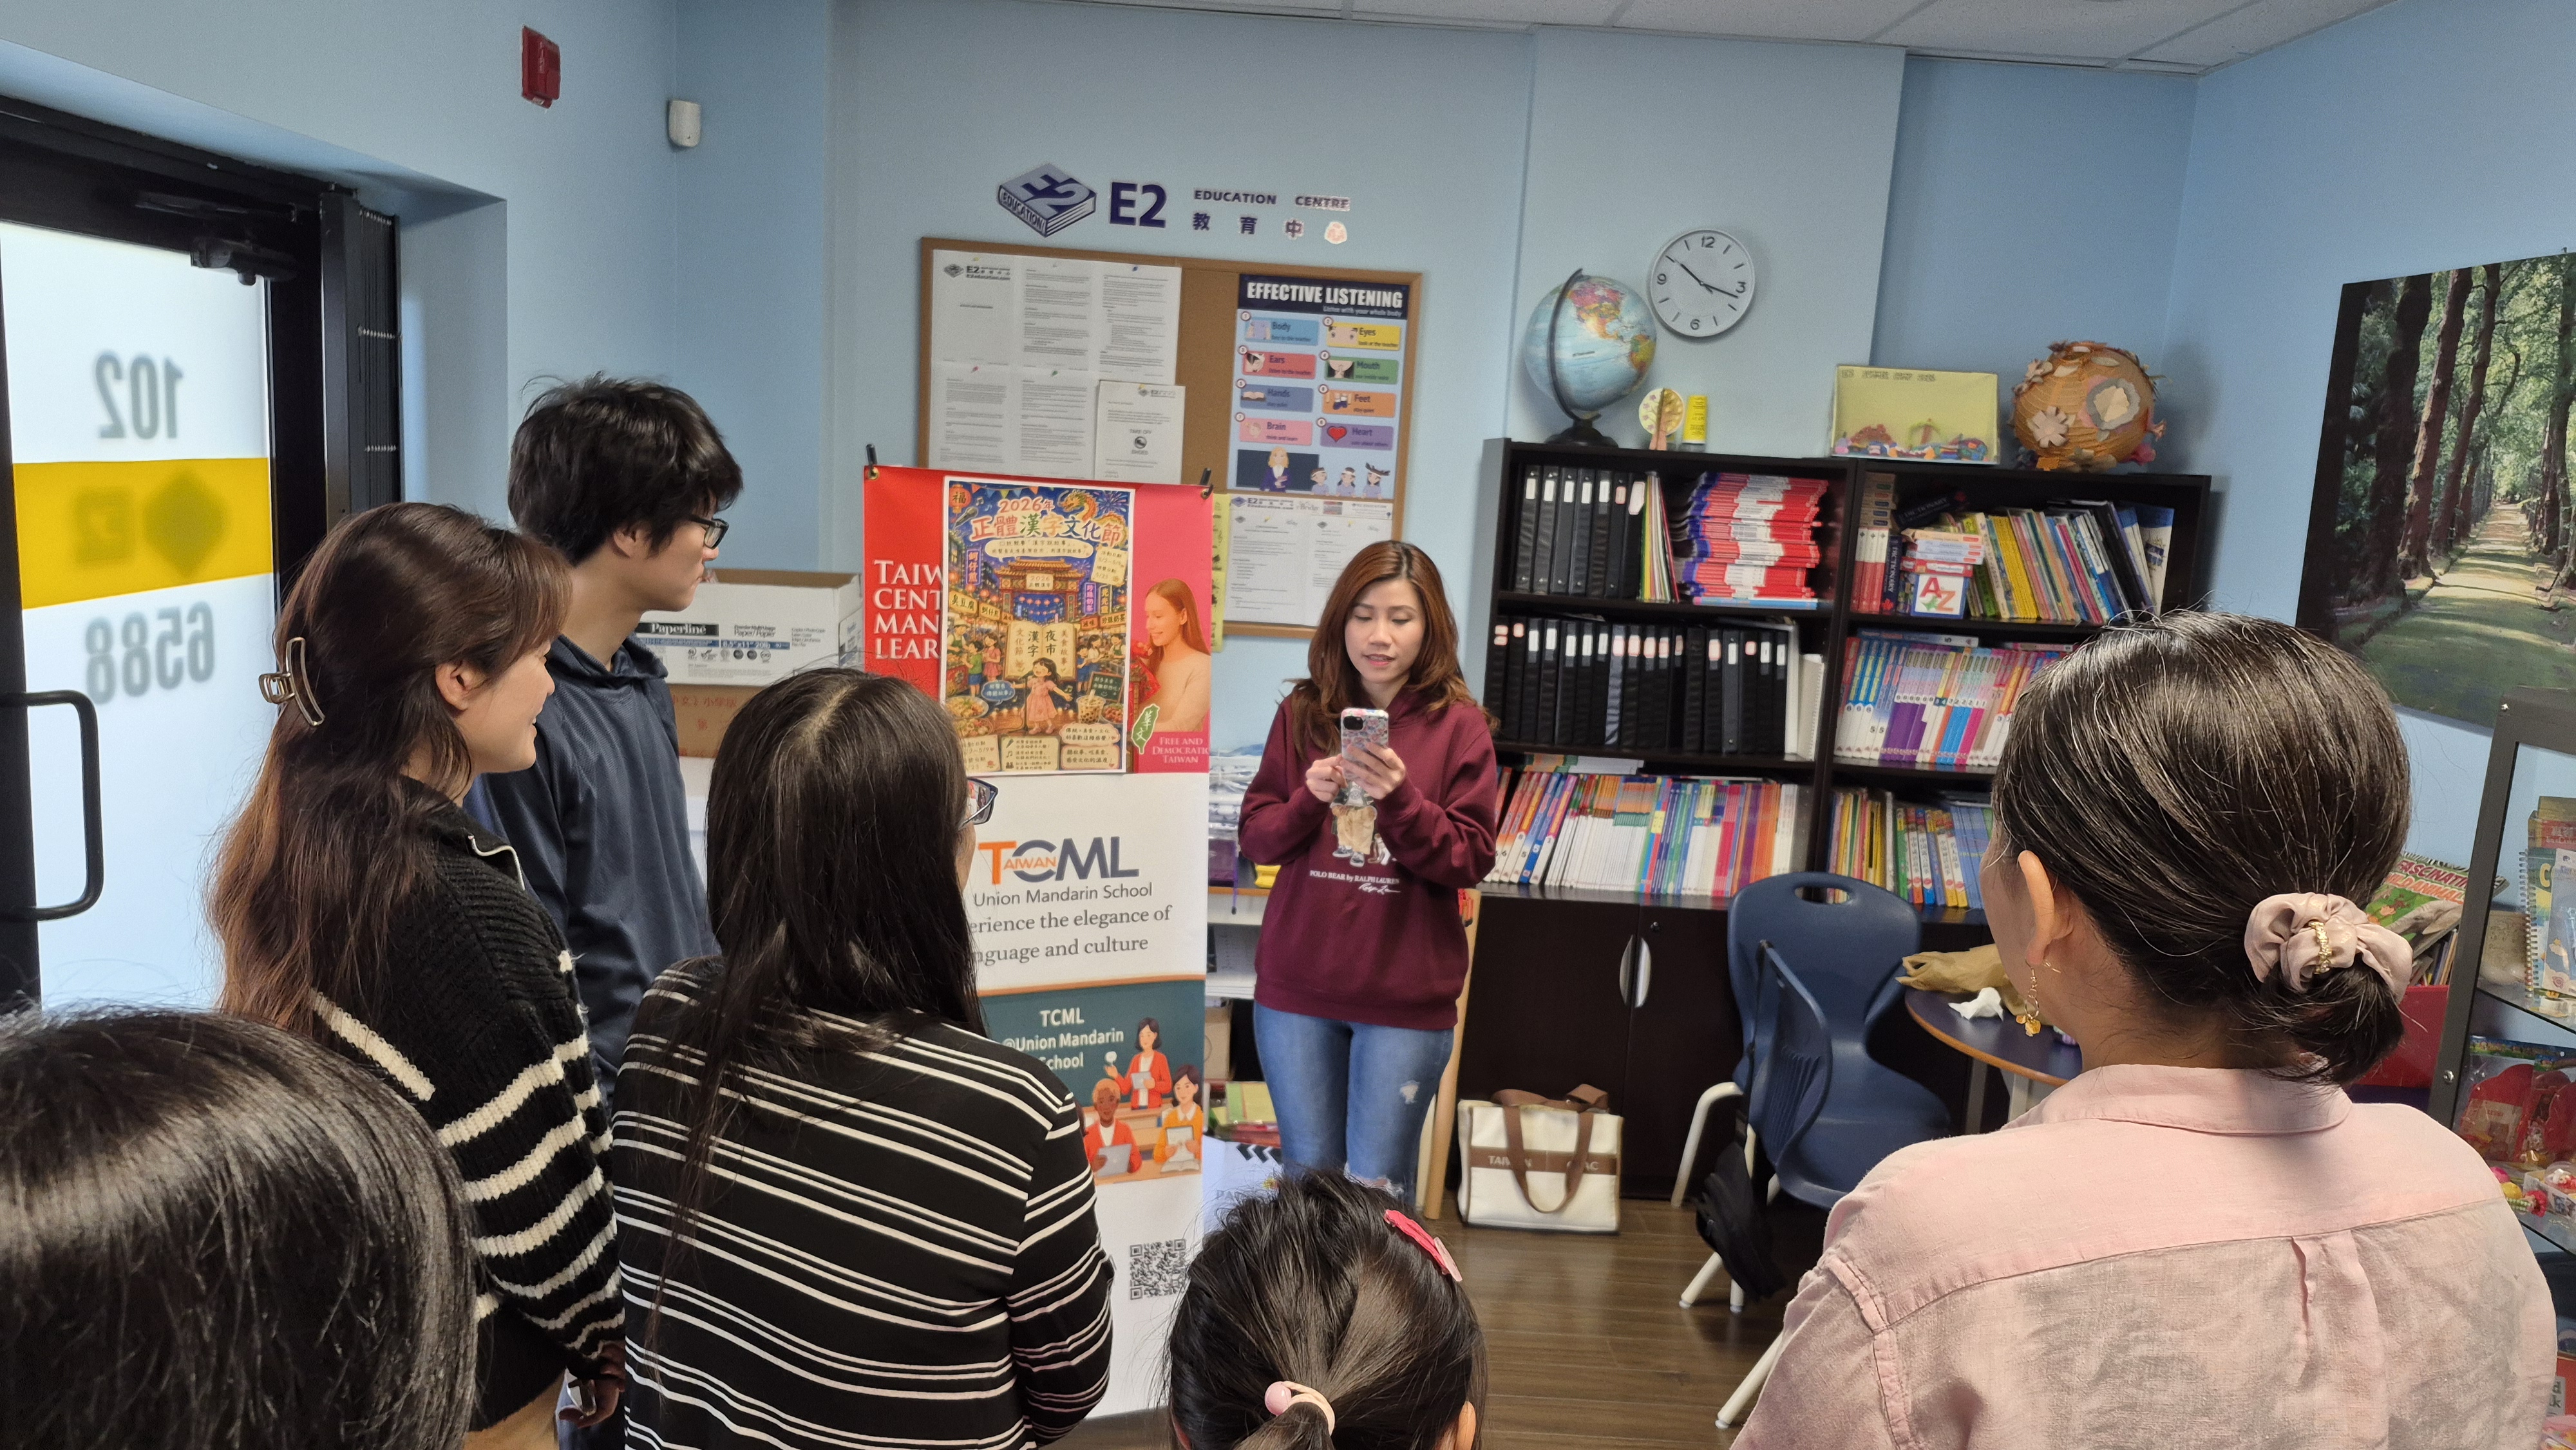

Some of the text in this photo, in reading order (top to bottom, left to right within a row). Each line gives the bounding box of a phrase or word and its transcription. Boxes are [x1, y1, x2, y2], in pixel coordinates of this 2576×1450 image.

[1110, 182, 1166, 228] E2
[1194, 190, 1349, 209] EDUCATION CENTRE
[1001, 191, 1044, 232] EDUCATION
[1701, 236, 1716, 249] 12
[1657, 273, 1667, 285] 9
[1737, 281, 1746, 293] 3
[1247, 282, 1402, 308] EFFECTIVE LISTENING
[1272, 322, 1291, 332] Body
[1359, 328, 1376, 337] Eyes
[1690, 318, 1700, 330] 6
[1357, 361, 1380, 370] Mouth
[1267, 388, 1290, 397] Hands
[1354, 394, 1370, 402] Feet
[1267, 422, 1285, 430] Brain
[1352, 428, 1372, 436] Heart
[952, 491, 966, 504] 福
[999, 498, 1055, 513] 2026年
[971, 513, 1122, 547] 正體漢字文化節
[1888, 547, 1899, 593] DICTIONARY
[952, 594, 974, 611] 臭豆腐
[1920, 578, 1956, 612] A Z
[873, 613, 940, 634] MAN
[1102, 614, 1125, 624] 珍珠奶茶
[651, 623, 706, 636] Paperline
[875, 637, 940, 659] LEAR
[1015, 629, 1023, 655] 文化節
[1028, 630, 1039, 657] 漢字
[1045, 630, 1056, 655] 夜市
[1136, 710, 1153, 742] 華文
[1160, 736, 1204, 746] FREE AND
[1162, 755, 1198, 764] TAIWAN
[978, 836, 1139, 885] TCML
[2539, 863, 2552, 887] C
[974, 882, 1153, 907] Union Mandarin School
[1041, 912, 1069, 929] the
[1074, 909, 1150, 929] elegance
[1153, 905, 1173, 921] of
[1045, 939, 1079, 957] and
[1084, 936, 1148, 953] culture
[1040, 1008, 1084, 1028] TCML
[1060, 1028, 1124, 1047] Mandarin
